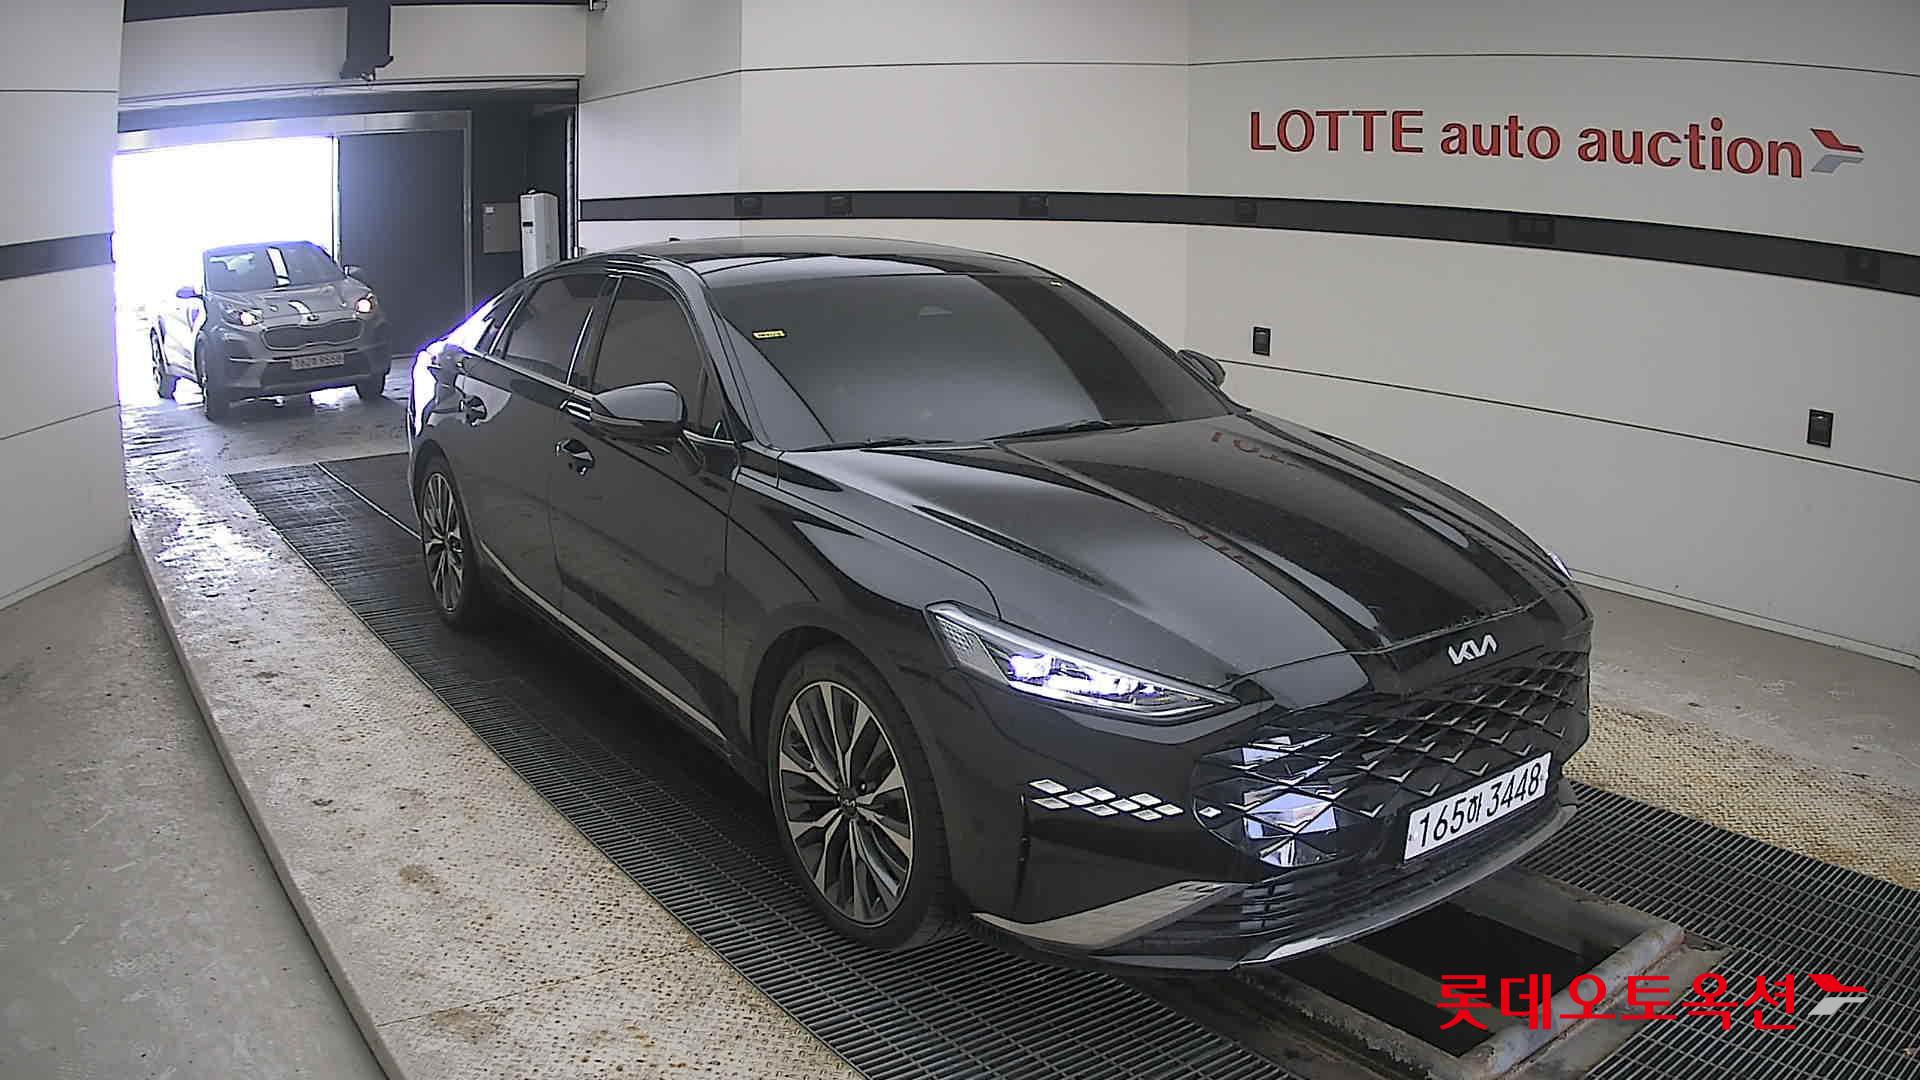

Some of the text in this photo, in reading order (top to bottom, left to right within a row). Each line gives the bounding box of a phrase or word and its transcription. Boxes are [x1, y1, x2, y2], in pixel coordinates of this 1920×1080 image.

[1250, 109, 1803, 178] LOTTE auto auction
[1448, 634, 1498, 665] KIA
[1486, 762, 1542, 817] 3448
